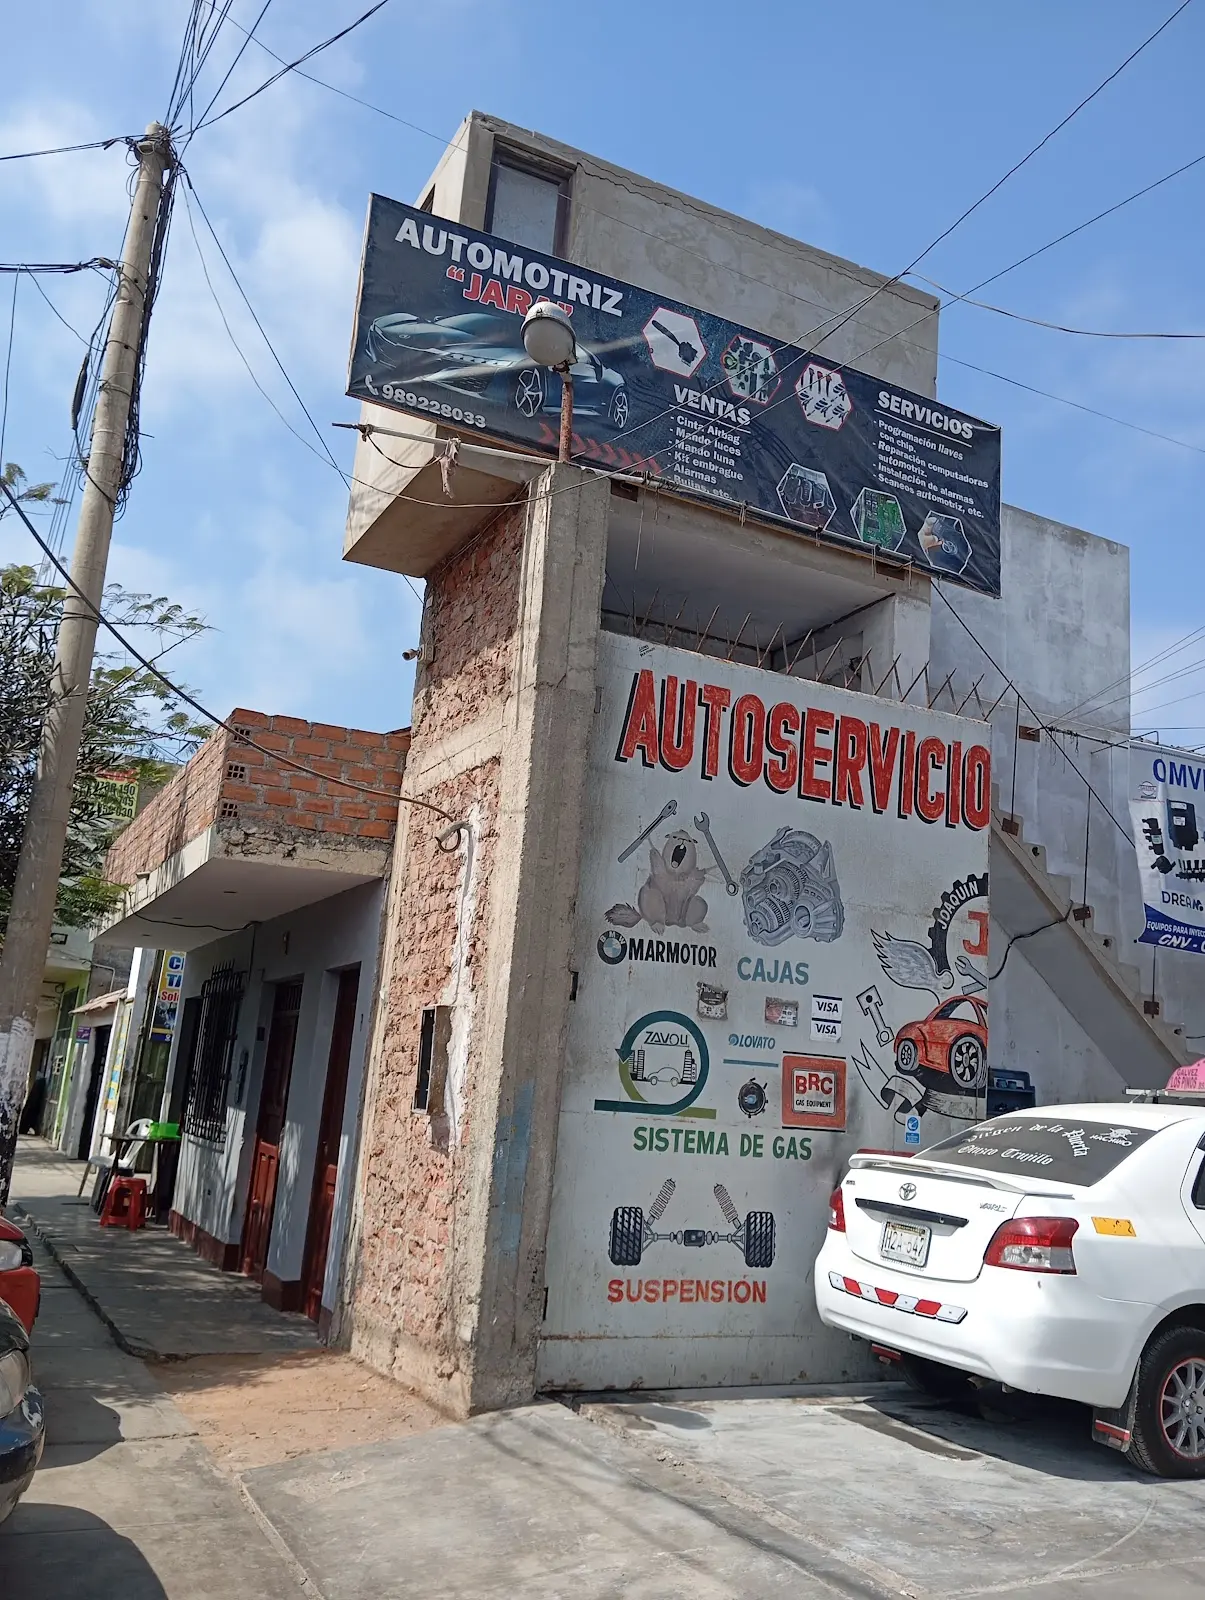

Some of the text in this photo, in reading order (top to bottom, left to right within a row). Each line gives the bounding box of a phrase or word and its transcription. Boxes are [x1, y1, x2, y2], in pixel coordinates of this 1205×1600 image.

[395, 217, 623, 317] AUTOMOTRIZ
[382, 384, 486, 428] 989228033
[673, 384, 751, 425] VENTAS
[878, 391, 973, 439] SERVICIOS
[676, 416, 741, 446] Cinta Airbag
[676, 427, 742, 456] Mando luces
[879, 419, 964, 461] Programación llaves
[880, 432, 917, 453] con chip.
[674, 451, 744, 481] Kit embrague
[675, 439, 735, 466] Mando luna
[878, 441, 989, 488] Reparación computadoras
[878, 453, 928, 478] automotriz.
[673, 463, 717, 484] Alarmas
[878, 462, 974, 505] Instalación de alarmas
[878, 473, 985, 518] Scaneos automotriz, etc.
[615, 669, 991, 831] AUTOSERVICIO
[937, 881, 979, 930] JOAQUIN
[962, 910, 989, 956] J
[1147, 921, 1172, 932] EQUIPOS
[1172, 925, 1188, 935] PARA
[628, 937, 717, 968] MARMOTOR
[737, 957, 810, 986] CAJAS
[816, 1000, 839, 1013] VISA
[643, 1030, 688, 1047] ZAVOLI
[738, 1034, 776, 1050] LOVATO
[815, 1023, 837, 1035] VISA
[795, 1073, 833, 1095] BRC
[806, 1100, 832, 1109] EQUIPMENT
[633, 1126, 812, 1161] SISTEMA DE GAS
[1001, 1148, 1054, 1166] Trujillo
